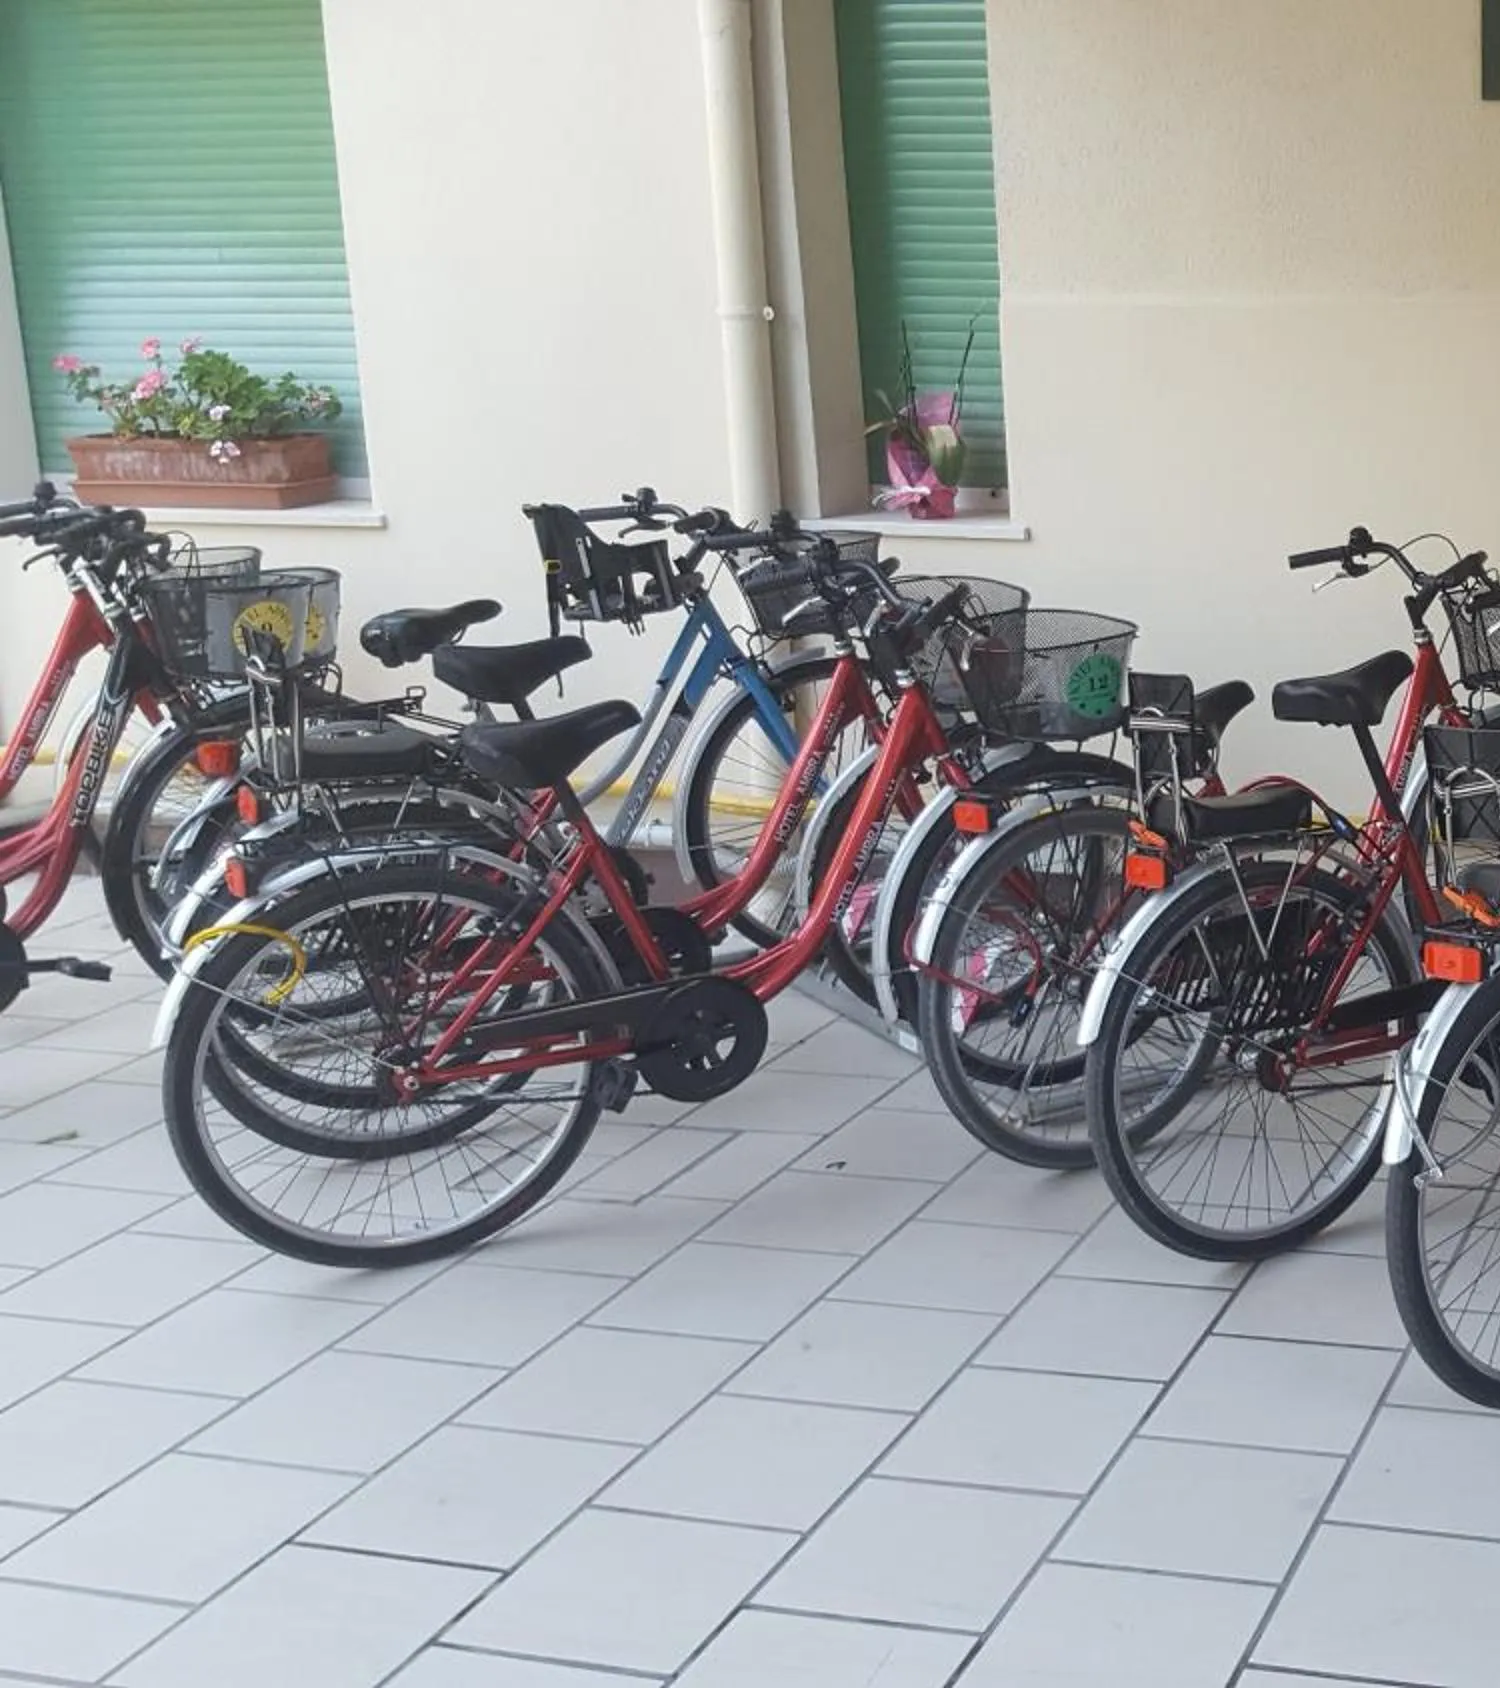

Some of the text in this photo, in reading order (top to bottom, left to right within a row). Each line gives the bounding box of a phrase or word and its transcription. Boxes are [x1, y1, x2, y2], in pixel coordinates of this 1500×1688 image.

[774, 750, 825, 843] HOTEL AMBRA
[830, 820, 883, 923] HOTEL AMBRA
